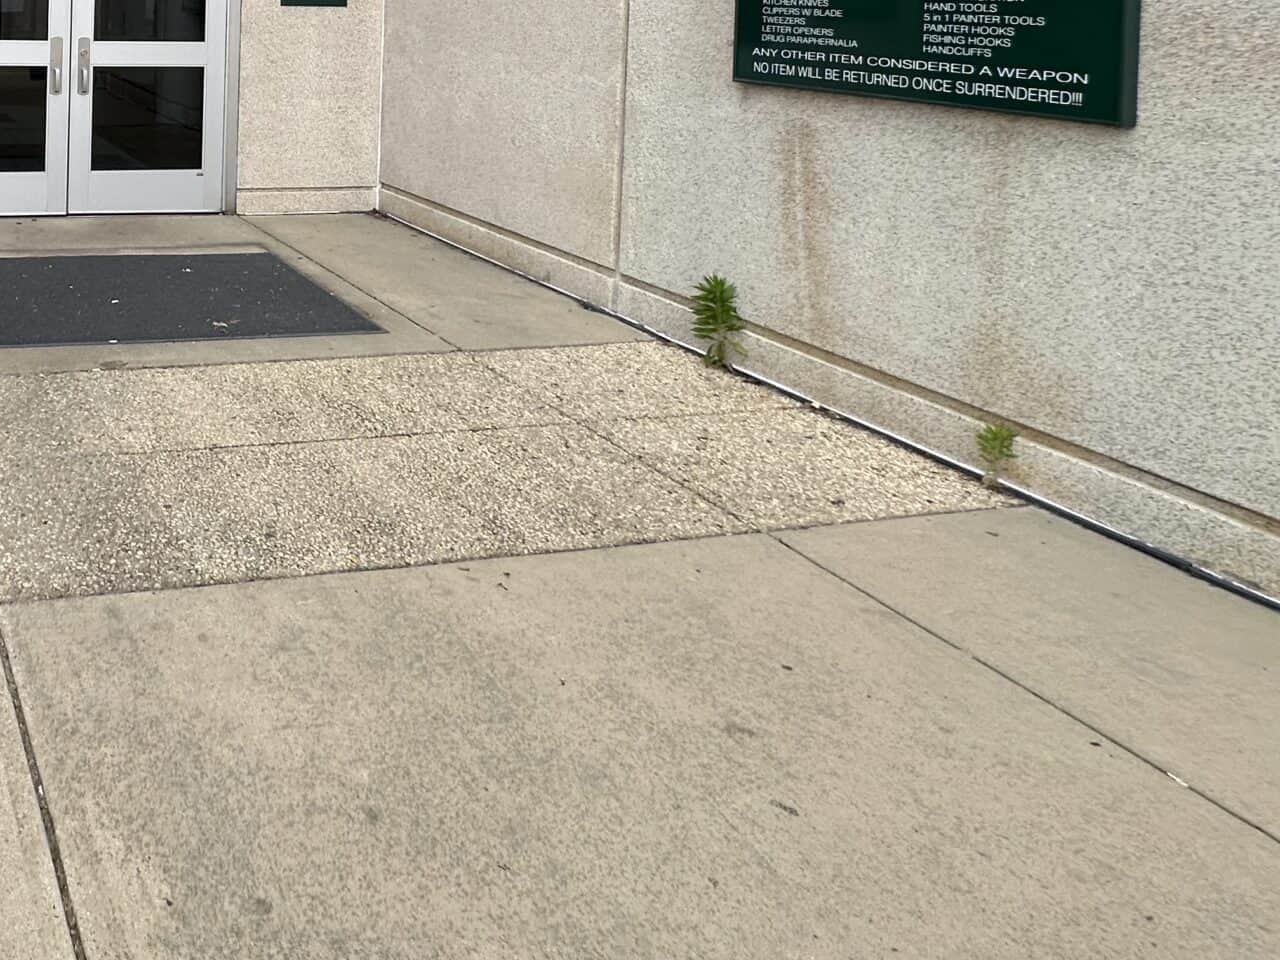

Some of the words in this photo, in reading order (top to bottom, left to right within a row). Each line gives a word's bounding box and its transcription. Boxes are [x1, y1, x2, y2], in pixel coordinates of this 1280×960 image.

[761, 6, 799, 15] CLIPPERS
[813, 8, 843, 17] BLADE
[923, 2, 956, 11] HAND
[959, 3, 997, 12] TOOLS
[762, 15, 805, 25] TWEEZERS
[923, 12, 930, 21] 5
[952, 13, 1000, 23] PAINTER
[1003, 15, 1045, 25] TOOLS
[761, 24, 791, 33] LETTER
[792, 26, 834, 36] OPENERS
[923, 23, 968, 33] PAINTER
[971, 25, 1015, 35] HOOKS
[761, 33, 784, 42] DRUG
[786, 35, 858, 47] PARAPHERNALIA
[922, 33, 965, 44] FISHING
[967, 36, 1011, 47] HOOKS
[922, 44, 991, 57] HANDCUFFS
[751, 47, 777, 57] ANY
[780, 49, 825, 61] OTHER
[829, 53, 862, 64] ITEM
[866, 56, 974, 74] CONSIDERED
[979, 64, 992, 76] A
[996, 66, 1088, 84] WEAPON
[753, 61, 769, 73] NO
[771, 63, 795, 76] ITEM
[797, 65, 821, 79] WILL
[824, 68, 839, 81] BE
[842, 69, 909, 88] RETURNED
[911, 76, 951, 92] ONCE
[955, 80, 1082, 106] SURRENDERED!!!
